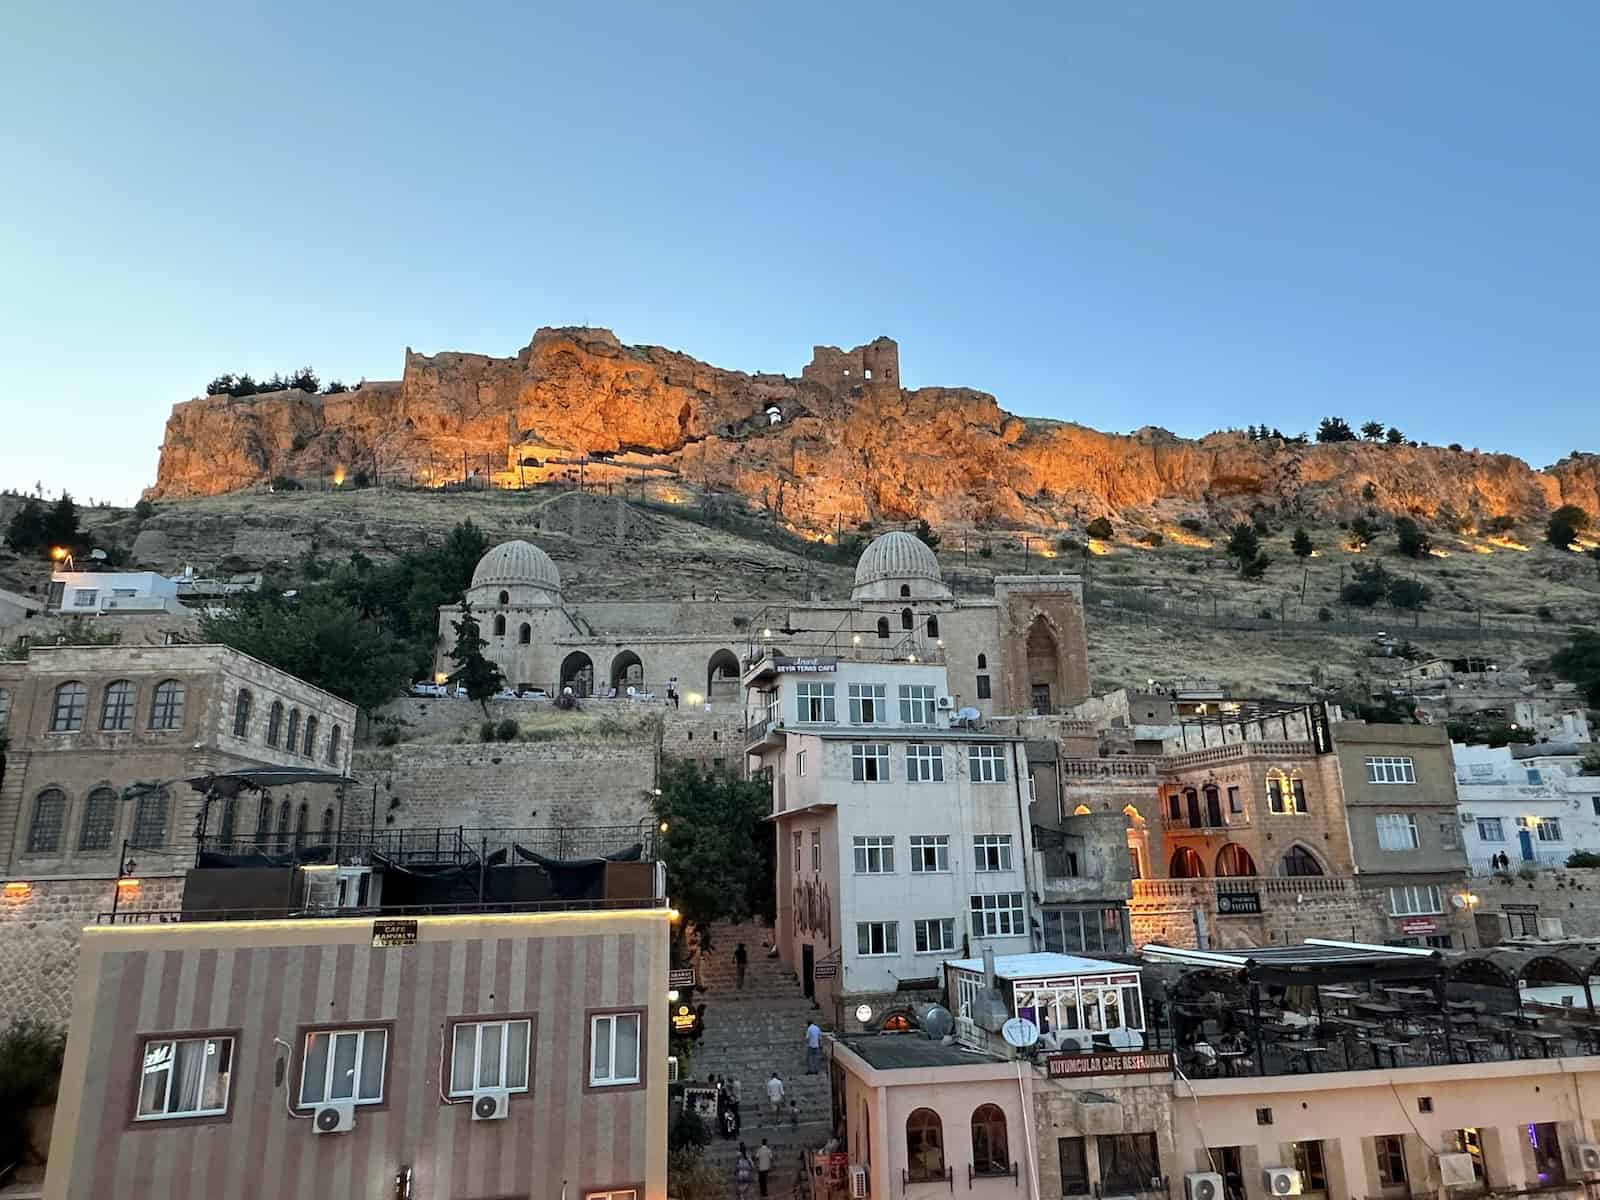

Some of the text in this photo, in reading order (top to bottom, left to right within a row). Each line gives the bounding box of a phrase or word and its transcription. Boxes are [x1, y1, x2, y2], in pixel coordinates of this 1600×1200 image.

[818, 664, 835, 672] CAFE
[1102, 1056, 1121, 1071] CAFE
[1122, 1054, 1170, 1070] RESTAURANT
